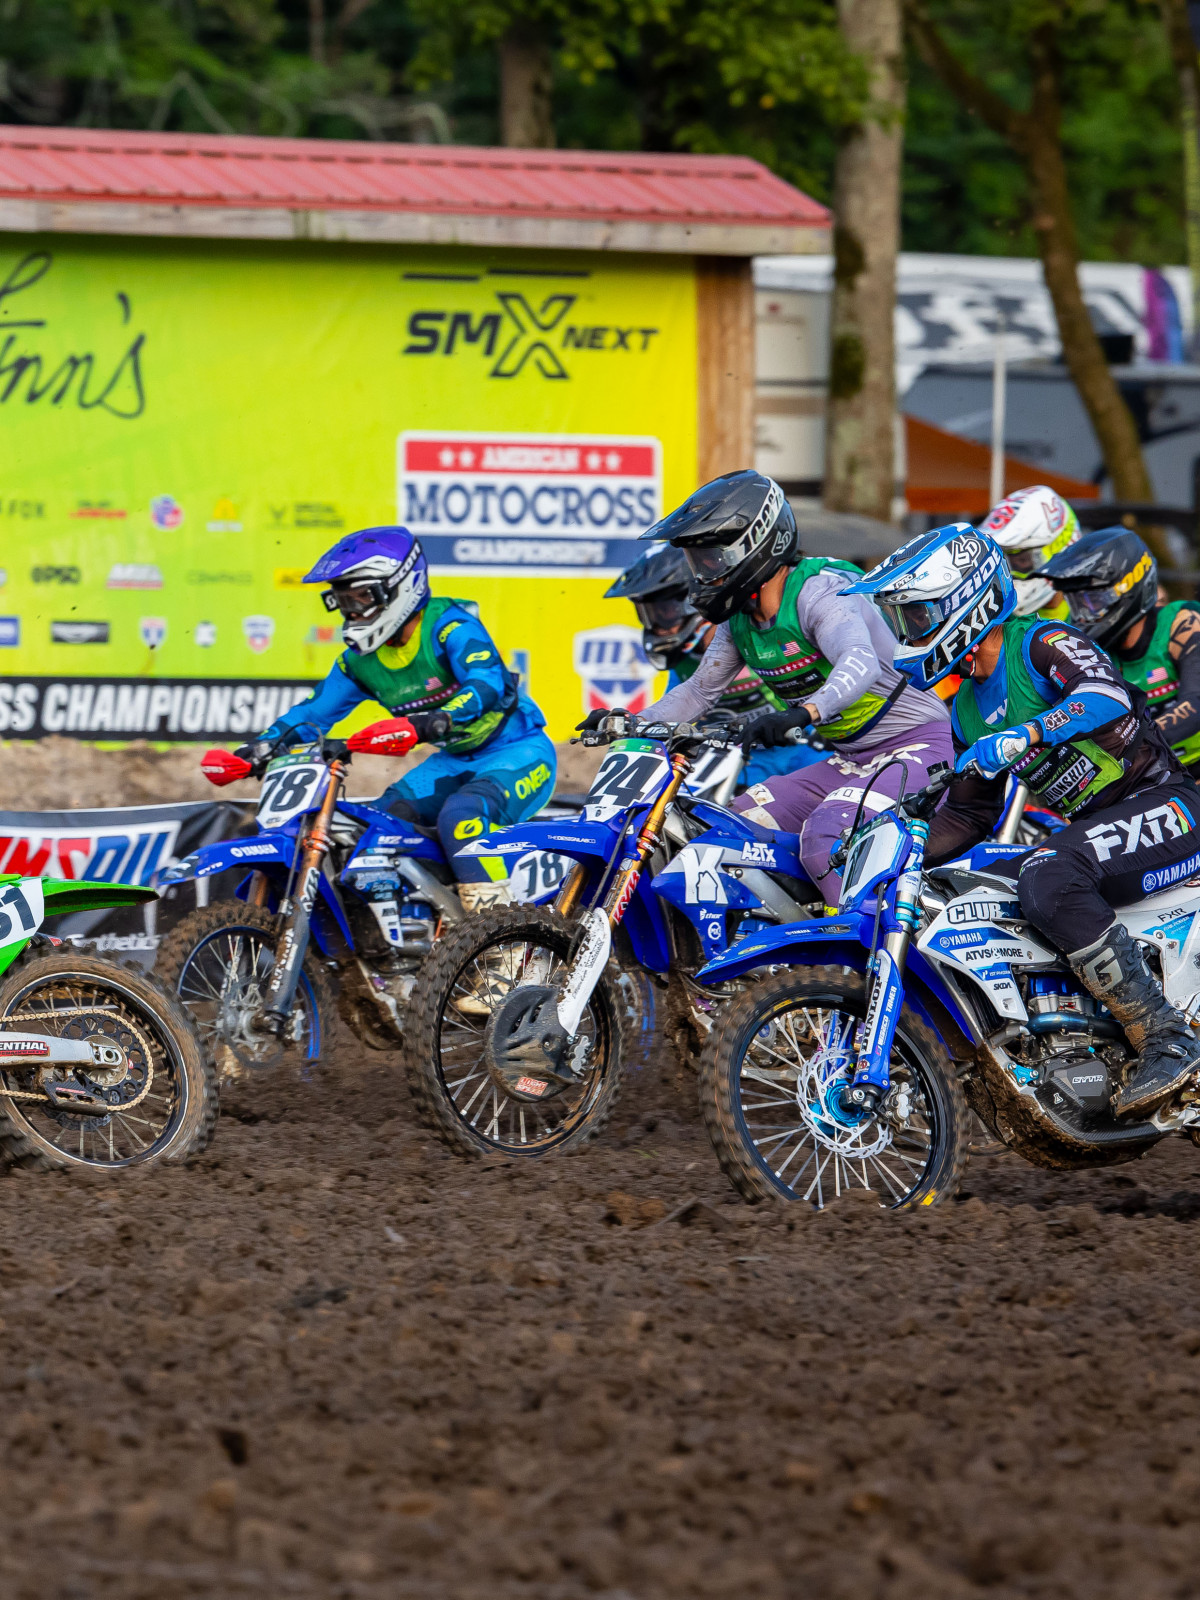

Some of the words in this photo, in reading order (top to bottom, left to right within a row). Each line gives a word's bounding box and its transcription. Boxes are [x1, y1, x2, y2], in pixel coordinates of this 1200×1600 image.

[403, 291, 577, 379] SMX
[563, 326, 659, 351] NEXT
[482, 447, 580, 471] AMERICAN
[404, 482, 656, 527] MOTOCROSS
[388, 541, 421, 588] SCOTT
[771, 530, 792, 556] 6D
[951, 537, 981, 569] 6D
[940, 588, 1000, 663] FXR
[258, 768, 318, 813] 78
[584, 752, 664, 808] 24
[1083, 803, 1184, 863] FXR
[518, 851, 563, 899] 78
[1157, 908, 1188, 922] FXR
[949, 931, 983, 946] YAMAHA
[861, 974, 883, 1052] DUNLOP
[1072, 1075, 1104, 1083] GYTR
